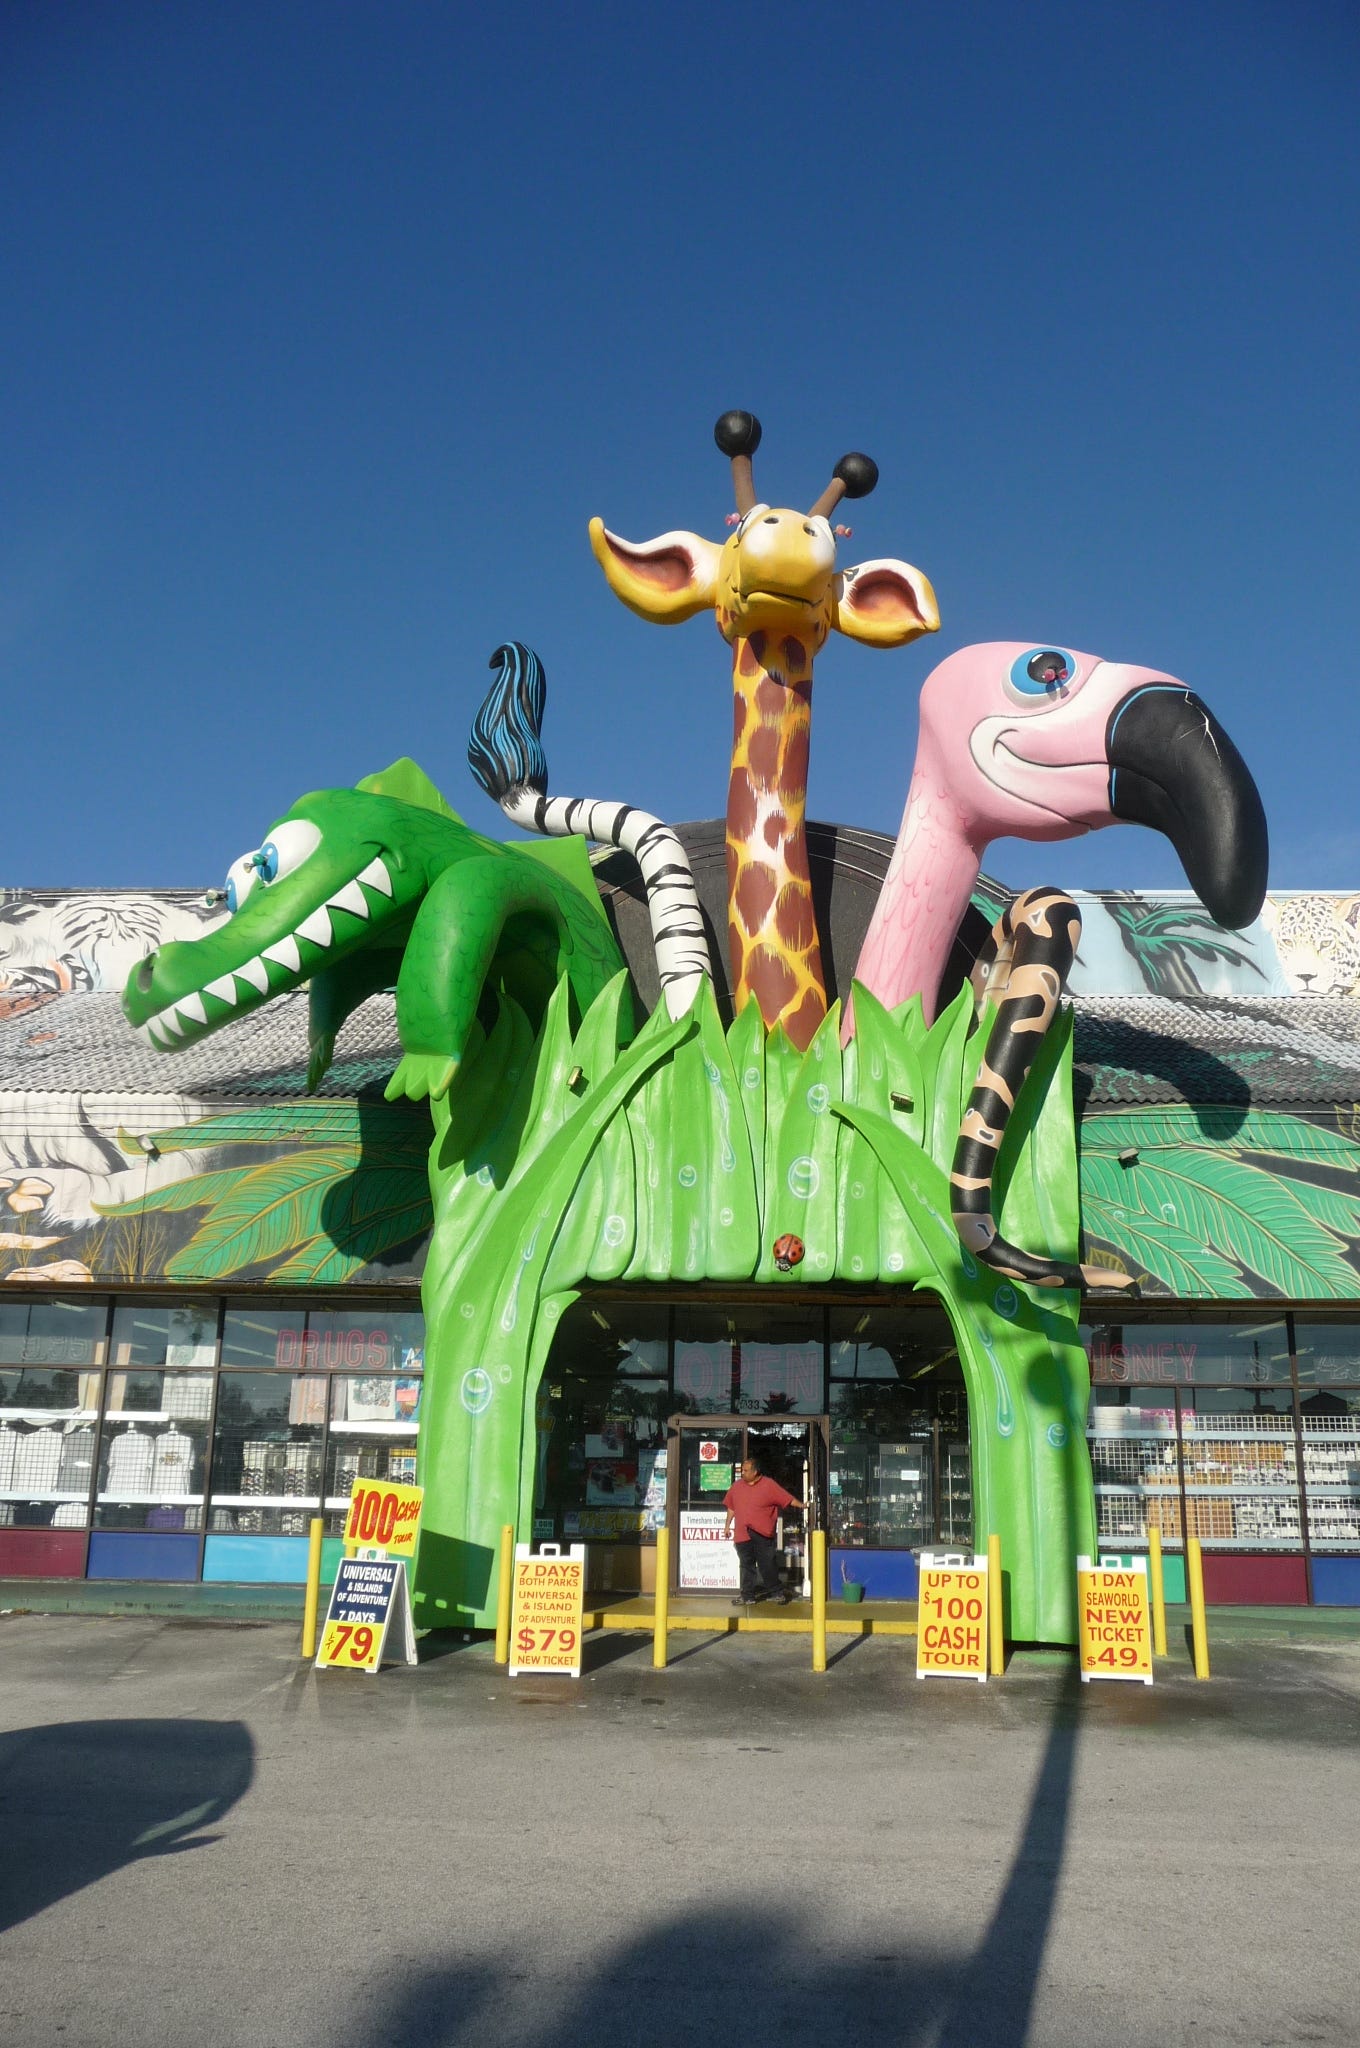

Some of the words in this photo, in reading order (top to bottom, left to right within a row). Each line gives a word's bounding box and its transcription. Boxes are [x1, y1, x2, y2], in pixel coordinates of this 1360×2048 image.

[276, 1329, 388, 1368] DRUGS
[678, 1350, 819, 1402] OPEN
[396, 1501, 422, 1521] CASH
[393, 1532, 413, 1544] TOUR
[684, 1528, 735, 1540] WANTED
[343, 1565, 393, 1583] UNIVERSAL
[520, 1565, 529, 1577] 7
[535, 1565, 580, 1577] DAYS
[519, 1578, 546, 1586] BOTH
[547, 1578, 578, 1587] PARKS
[928, 1573, 952, 1588] UP
[955, 1574, 980, 1589] TO
[1090, 1574, 1097, 1587] 1
[1103, 1573, 1136, 1588] DAY
[347, 1582, 353, 1591] &
[354, 1582, 383, 1594] ISLANDS
[337, 1592, 346, 1602] OF
[347, 1593, 388, 1606] ADVENTURE
[518, 1591, 578, 1600] UNIVERSAL
[1086, 1592, 1139, 1607] SEAWORLD
[523, 1602, 530, 1611] &
[532, 1602, 572, 1611] ISLAND
[924, 1591, 982, 1621] $100
[339, 1610, 346, 1621] 7
[348, 1610, 376, 1623] DAYS
[518, 1615, 528, 1624] OF
[529, 1615, 576, 1625] ADVENTURE
[1086, 1609, 1142, 1624] NEW
[516, 1627, 576, 1654] $79
[924, 1625, 980, 1650] CASH
[1088, 1627, 1144, 1643] TICKET
[518, 1655, 541, 1665] NEW
[543, 1655, 575, 1666] TICKET
[922, 1652, 980, 1666] TOUR
